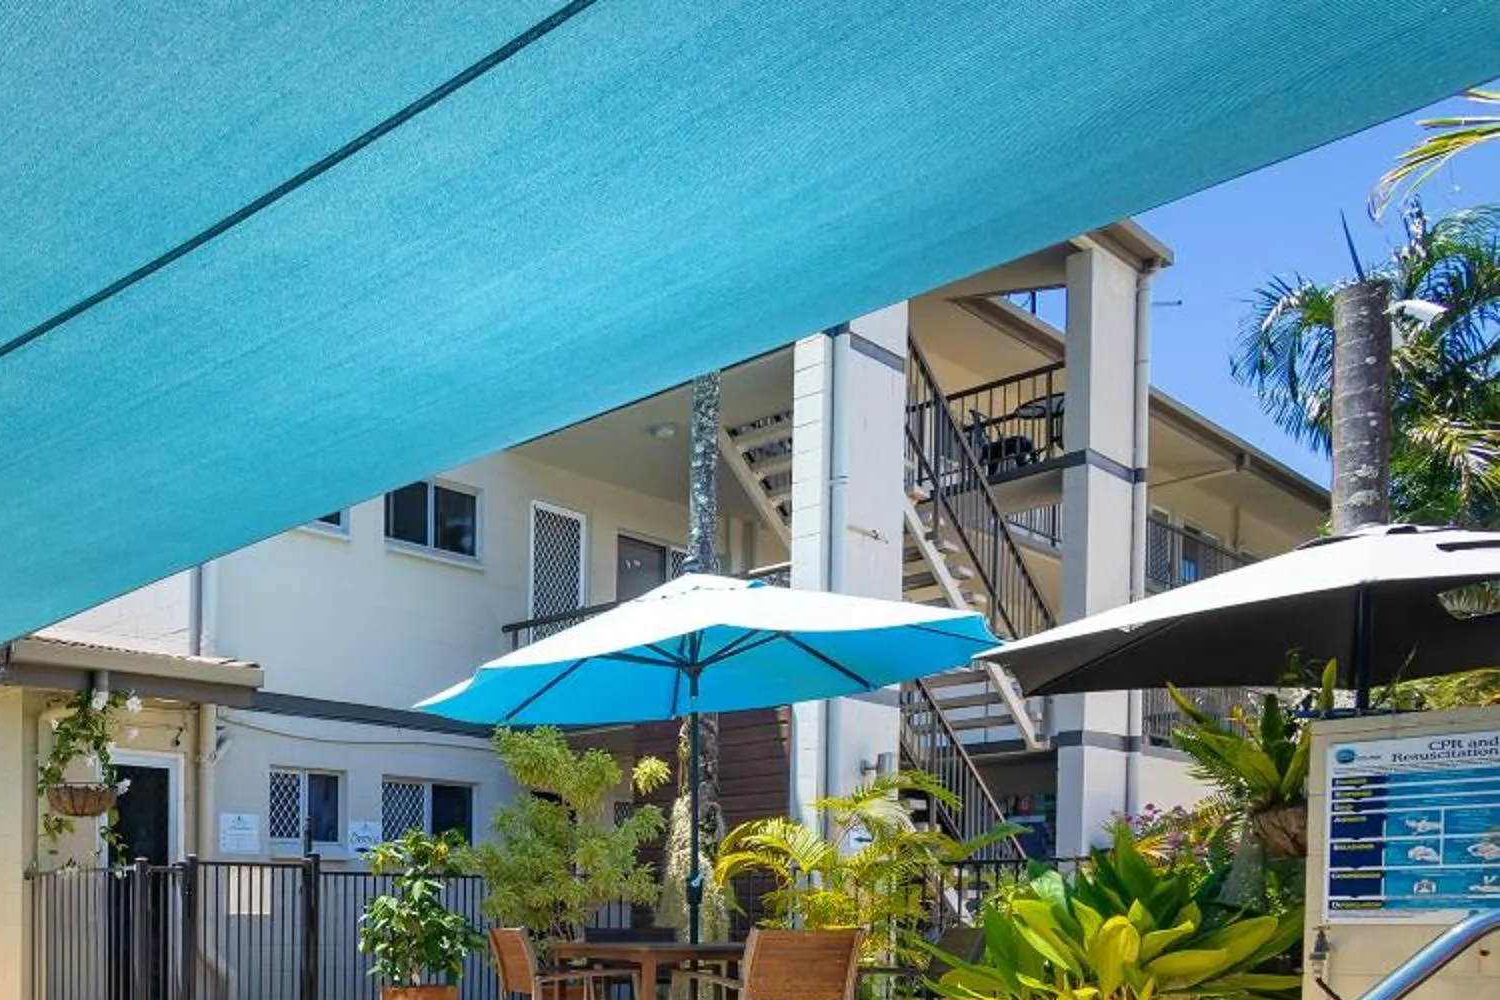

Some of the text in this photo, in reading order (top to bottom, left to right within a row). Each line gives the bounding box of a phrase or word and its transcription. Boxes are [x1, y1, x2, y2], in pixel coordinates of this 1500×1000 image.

[1428, 736, 1499, 751] CPR and
[1391, 747, 1500, 762] Resuscitation
